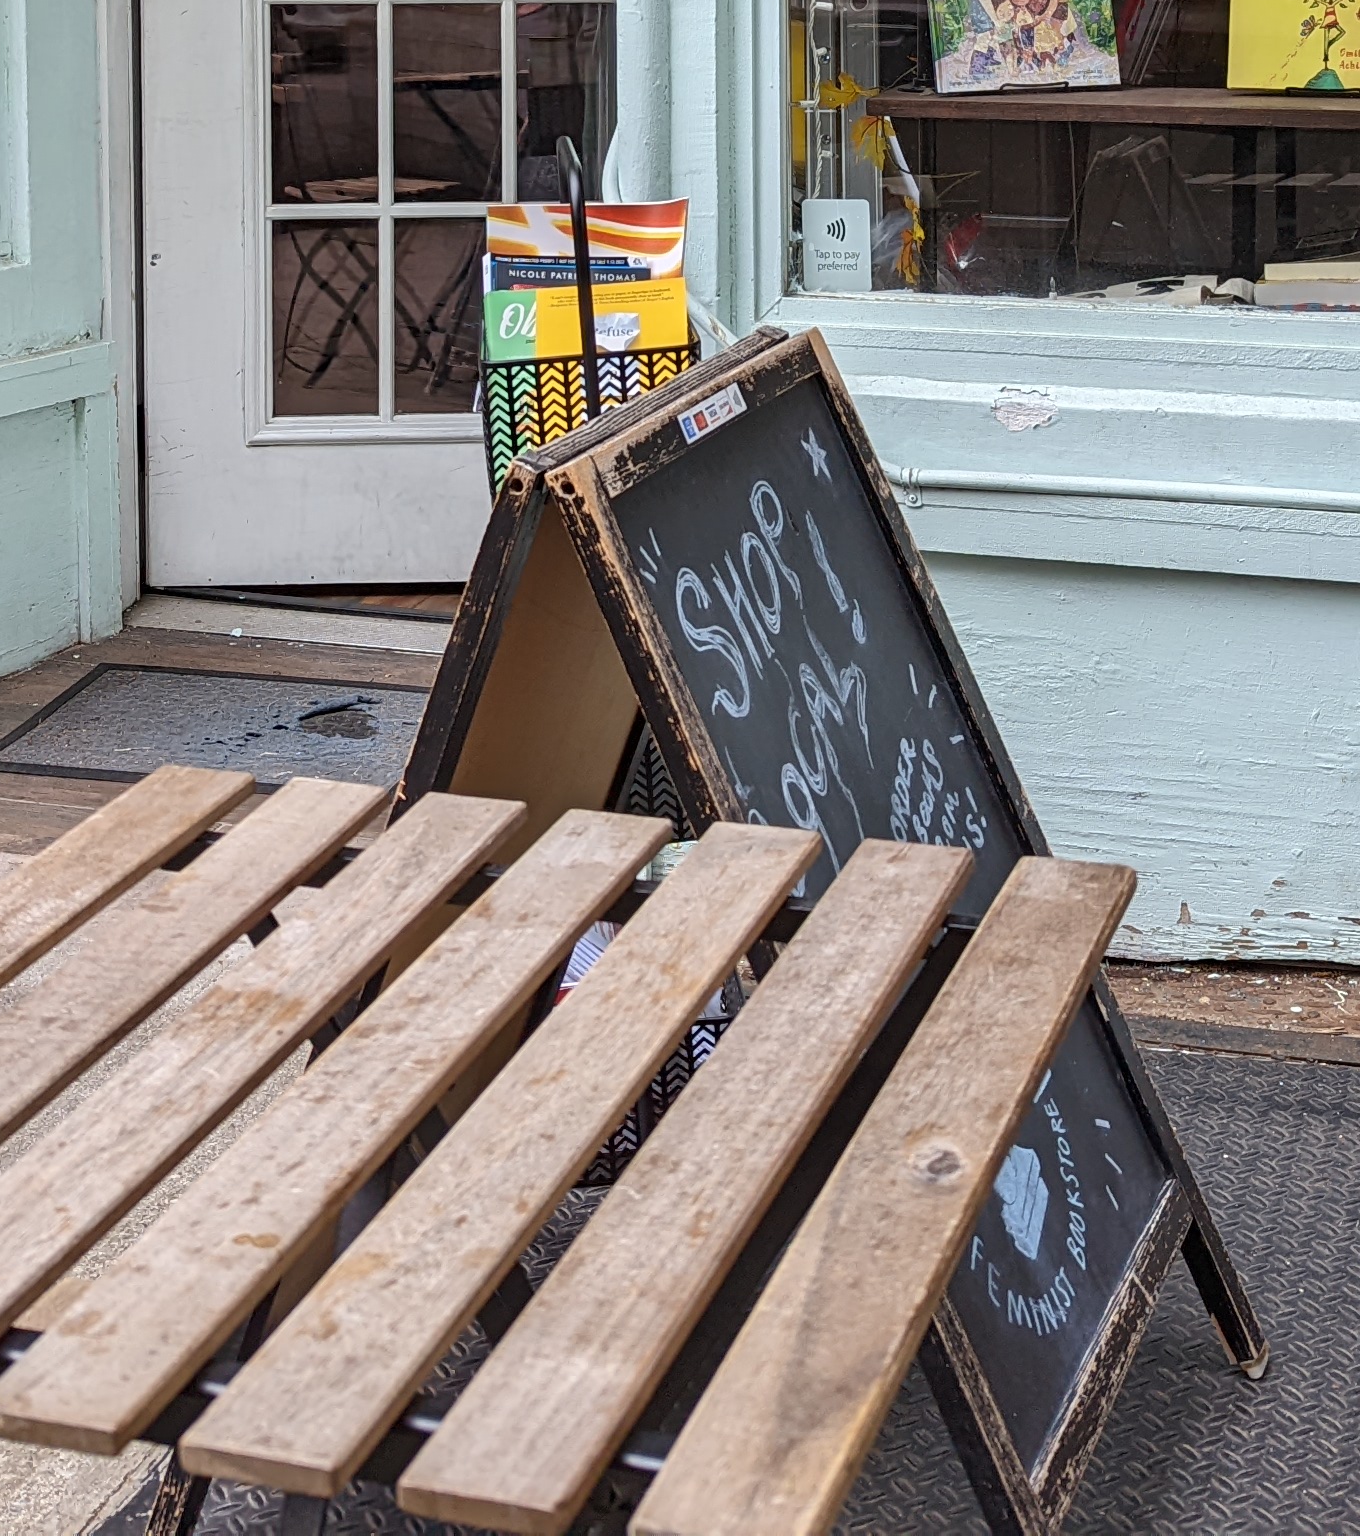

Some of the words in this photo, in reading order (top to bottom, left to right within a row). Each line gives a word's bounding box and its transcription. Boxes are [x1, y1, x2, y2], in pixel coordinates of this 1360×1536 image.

[508, 268, 547, 280] NICOLE
[593, 272, 637, 282] THOMAS
[814, 249, 831, 261] Tap
[832, 250, 842, 259] to
[844, 251, 861, 262] pay
[817, 260, 858, 273] preferred
[675, 480, 804, 719] SHOP
[889, 736, 917, 843] ORDER
[911, 738, 944, 845] BOOKS
[1043, 1097, 1087, 1271] BOOKSTORE
[970, 1234, 1076, 1337] FEMINIST
